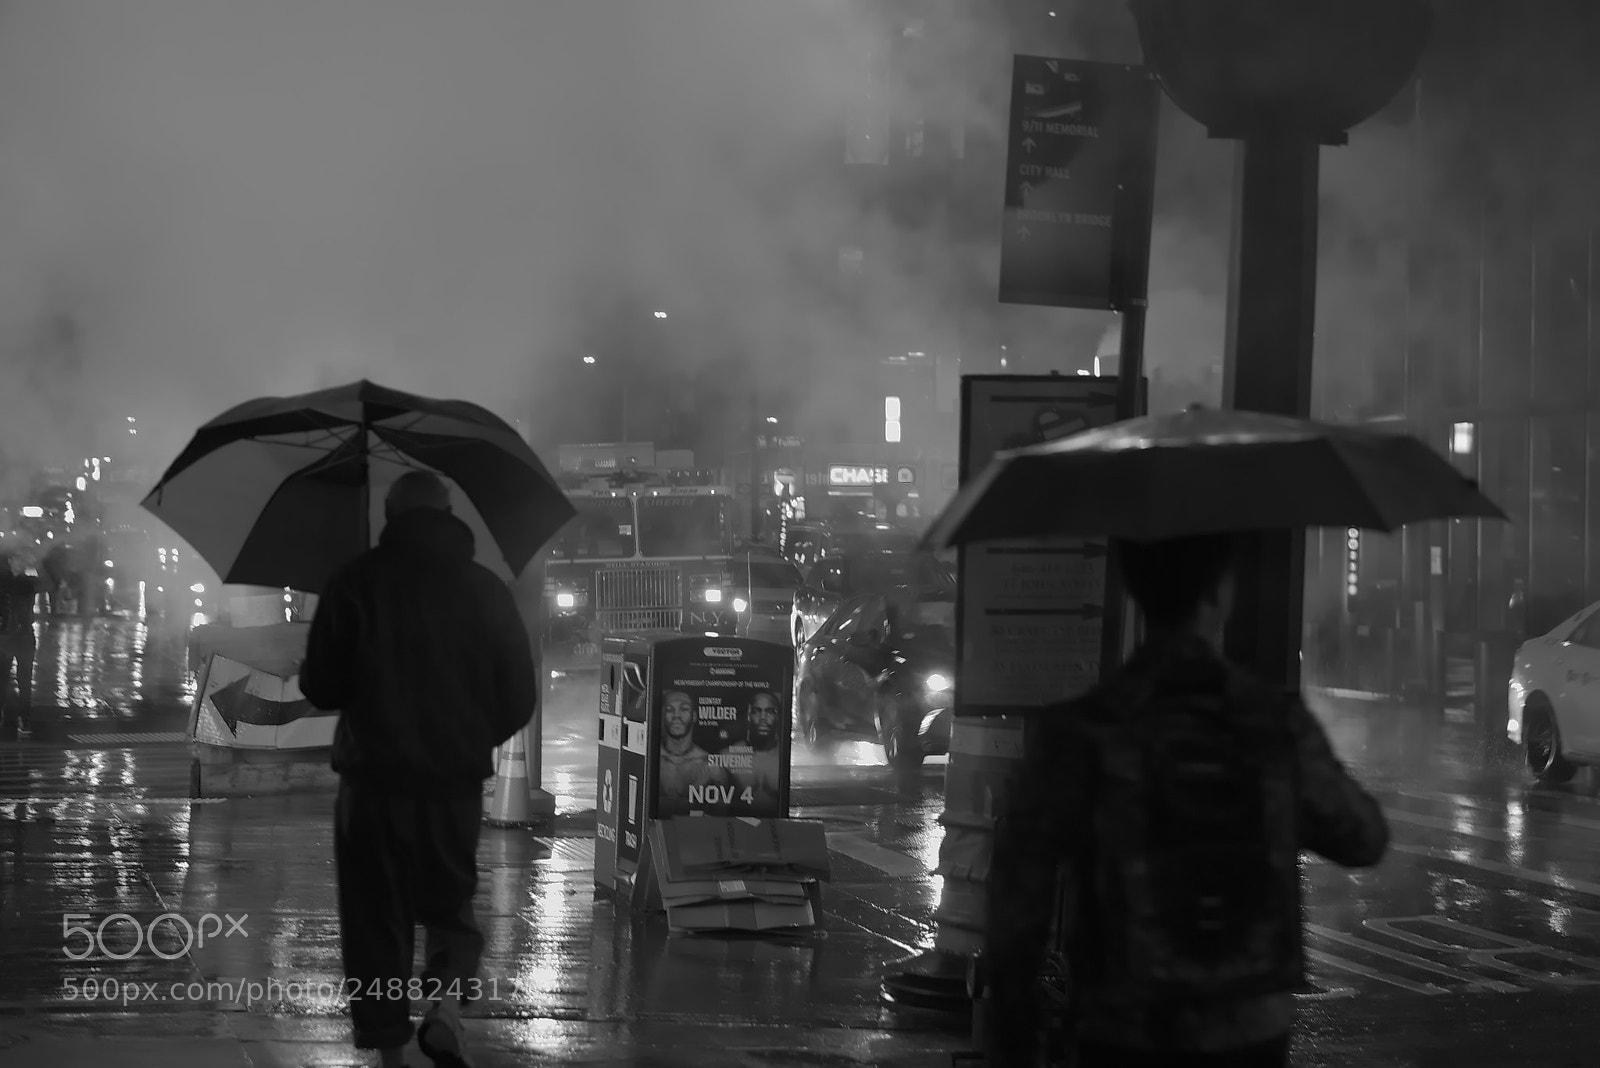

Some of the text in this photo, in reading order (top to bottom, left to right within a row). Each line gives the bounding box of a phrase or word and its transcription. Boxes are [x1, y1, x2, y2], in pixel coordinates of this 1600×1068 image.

[1022, 120, 1099, 138] 9/11 MEMORIAL
[1019, 164, 1070, 179] CITY HALL
[1016, 209, 1111, 227] BROOKLYN BRIDGE
[698, 705, 737, 721] WILDER
[707, 754, 753, 768] STIVERNE
[688, 784, 754, 805] NOV 4
